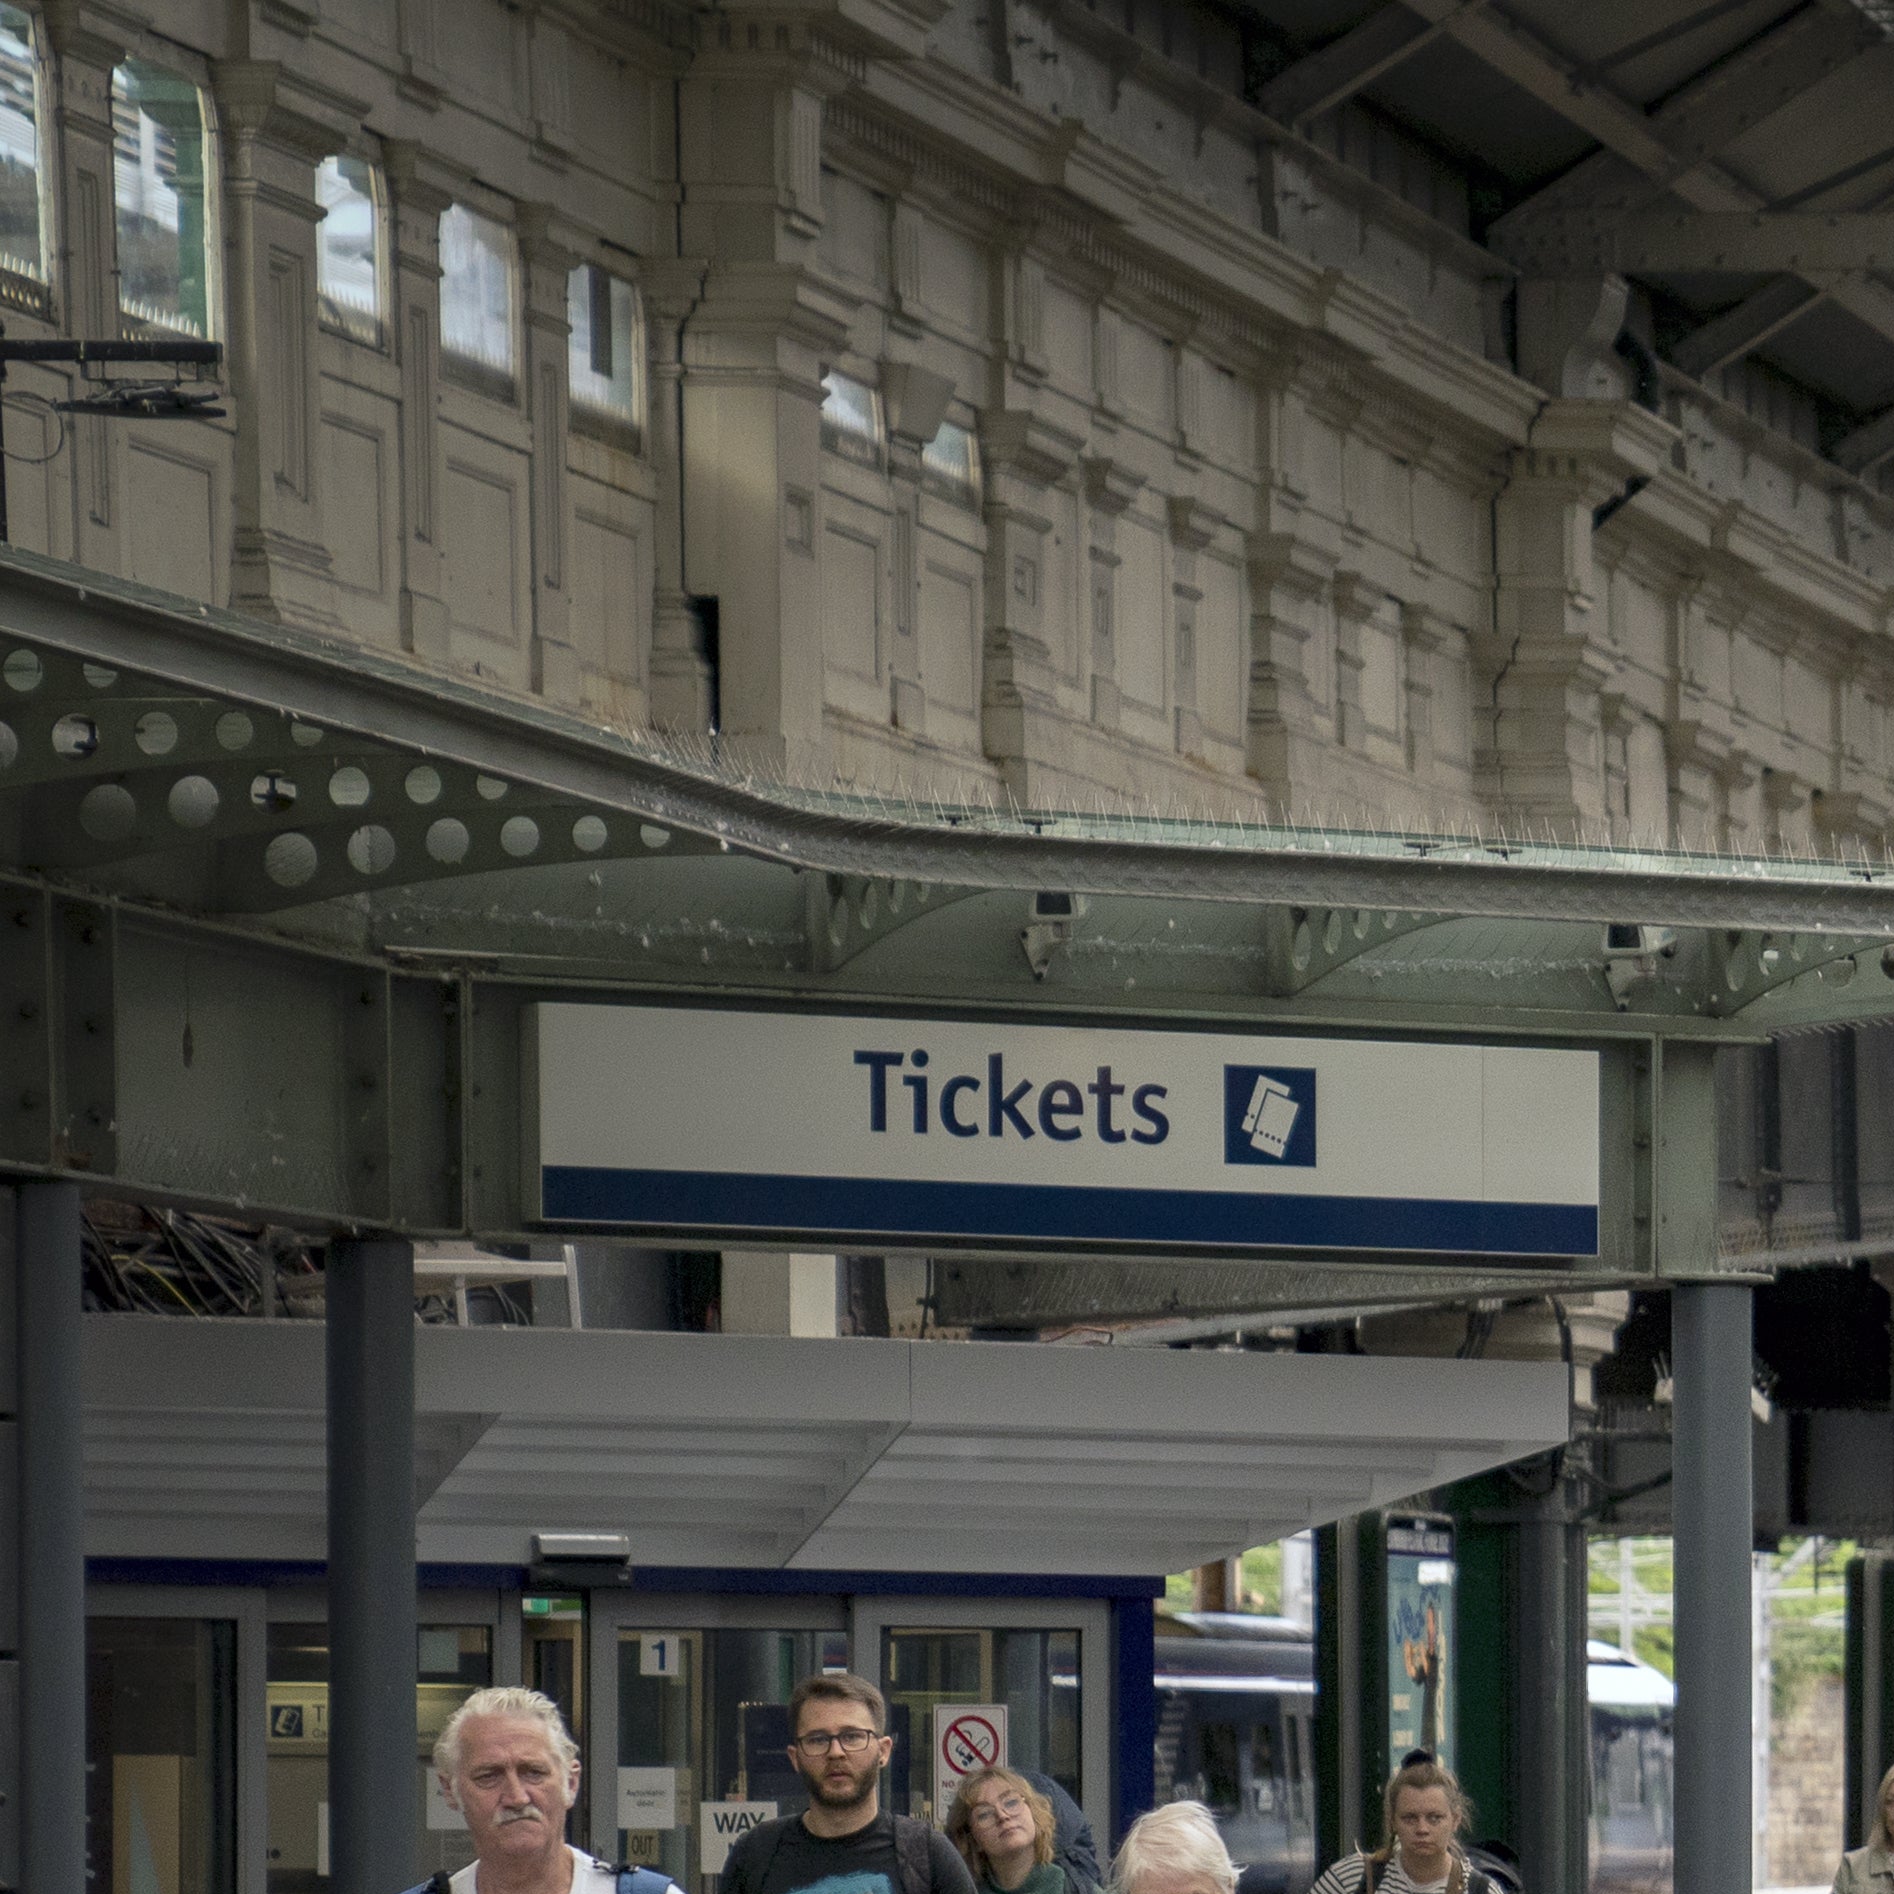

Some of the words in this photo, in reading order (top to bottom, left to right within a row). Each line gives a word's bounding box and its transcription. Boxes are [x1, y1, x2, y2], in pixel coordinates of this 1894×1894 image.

[853, 1049, 1170, 1145] Tickets
[651, 1639, 666, 1671] 1
[713, 1812, 766, 1834] WAY
